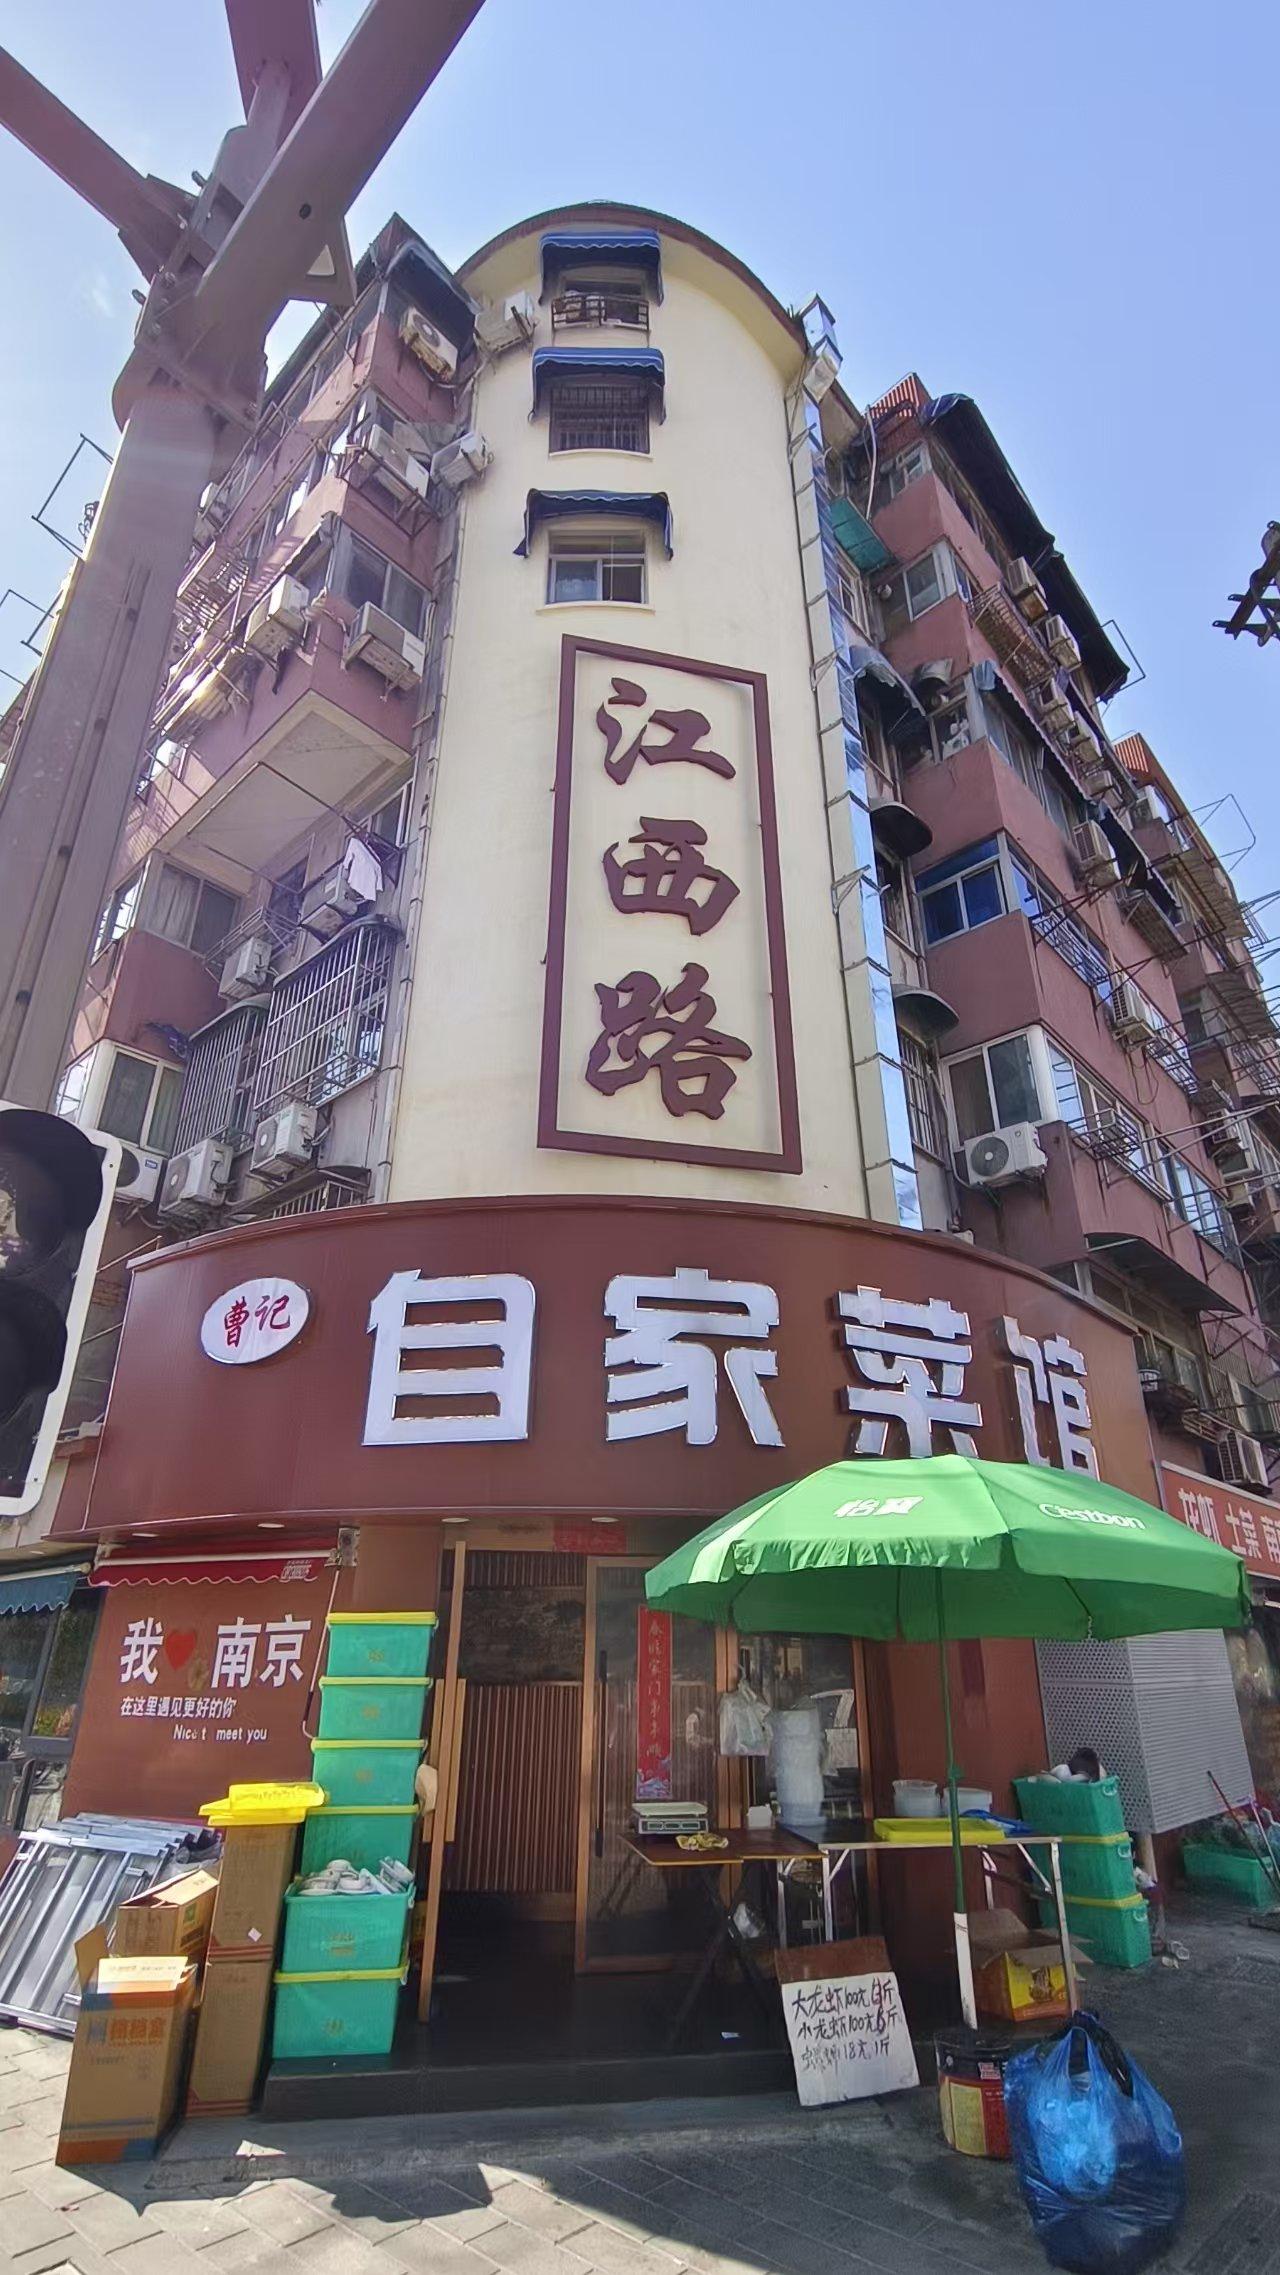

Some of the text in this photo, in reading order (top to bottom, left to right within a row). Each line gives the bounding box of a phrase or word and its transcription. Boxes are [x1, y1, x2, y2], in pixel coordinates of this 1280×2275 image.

[585, 677, 752, 1120] 江西路
[224, 1295, 291, 1348] 曹记
[361, 1266, 1100, 1483] 自家菜馆
[211, 1613, 311, 1688] 南京
[120, 1696, 237, 1719] 在这里遇见更好的你
[215, 1727, 243, 1741] meet
[246, 1728, 268, 1745] you
